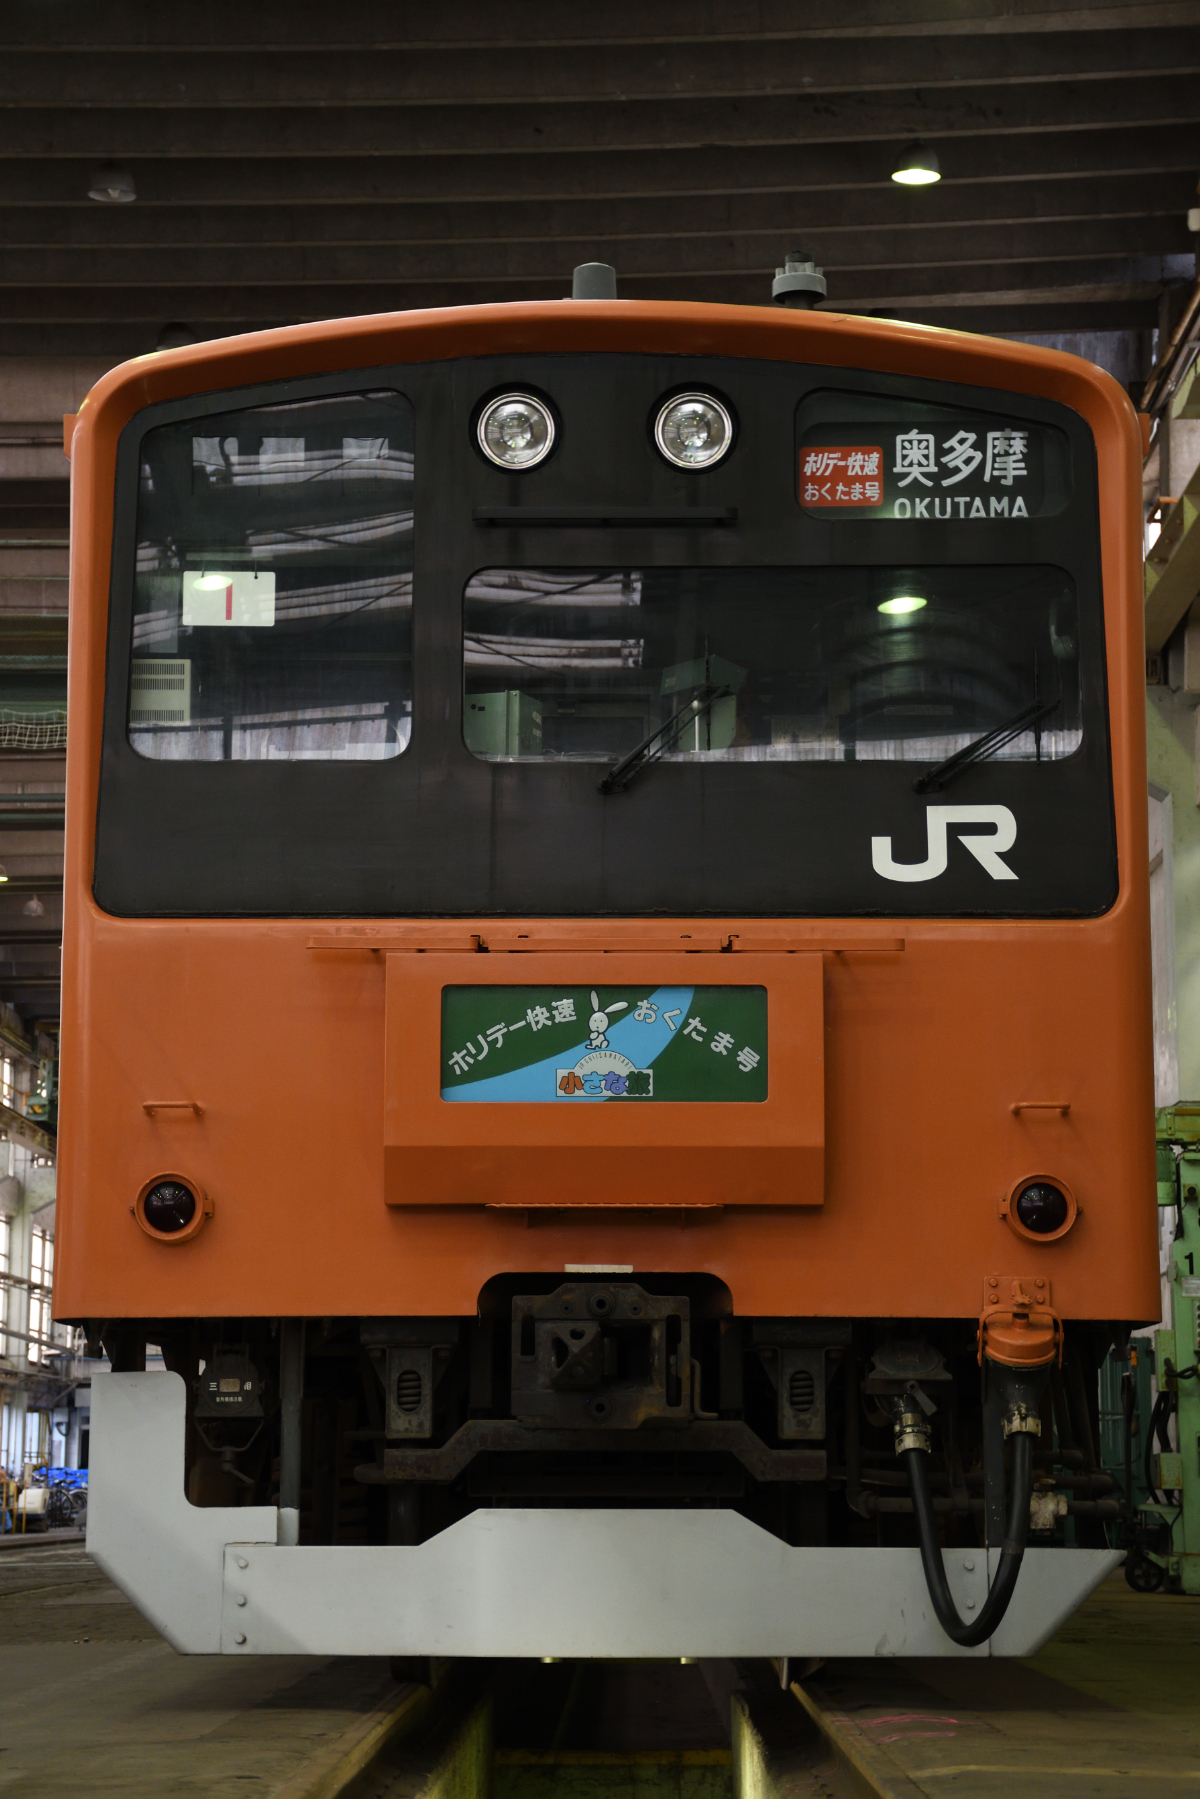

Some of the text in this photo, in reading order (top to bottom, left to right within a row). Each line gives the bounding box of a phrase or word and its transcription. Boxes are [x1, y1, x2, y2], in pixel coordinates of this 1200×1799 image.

[804, 452, 880, 476] ホリデー快速
[893, 428, 1028, 487] 奥多摩
[804, 482, 880, 501] おくたま号
[893, 496, 1029, 518] OKUTAMA
[871, 805, 1019, 882] JR
[448, 998, 577, 1075] ホリデー快速
[633, 999, 761, 1074] おくたま号
[559, 1071, 651, 1095] 小さな旅
[1184, 1252, 1194, 1275] 1
